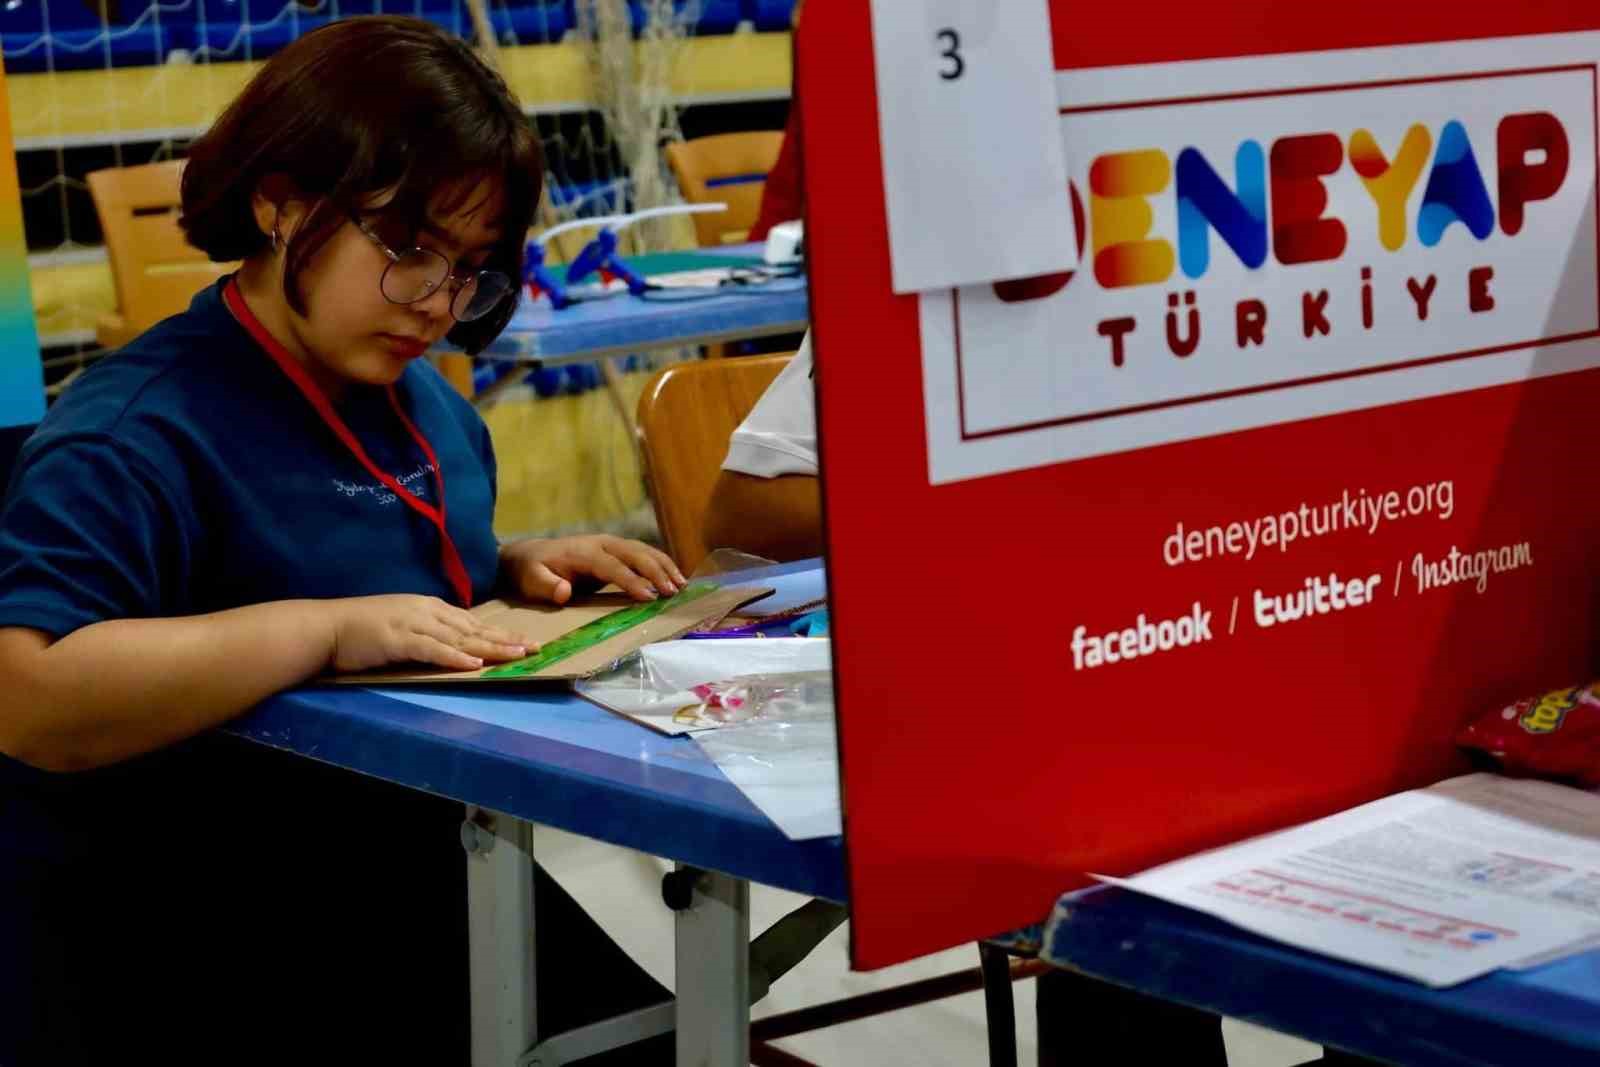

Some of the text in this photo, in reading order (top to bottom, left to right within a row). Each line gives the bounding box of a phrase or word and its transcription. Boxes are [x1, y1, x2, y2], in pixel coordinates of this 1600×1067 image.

[936, 28, 966, 81] 3
[993, 111, 1570, 303] ENEYAP
[1097, 266, 1495, 368] TÜRKİYE
[1163, 480, 1454, 566] deneyapturkiye.org
[1070, 602, 1212, 670] facebook
[1254, 573, 1381, 627] twitter
[1412, 540, 1533, 594] Instagram
